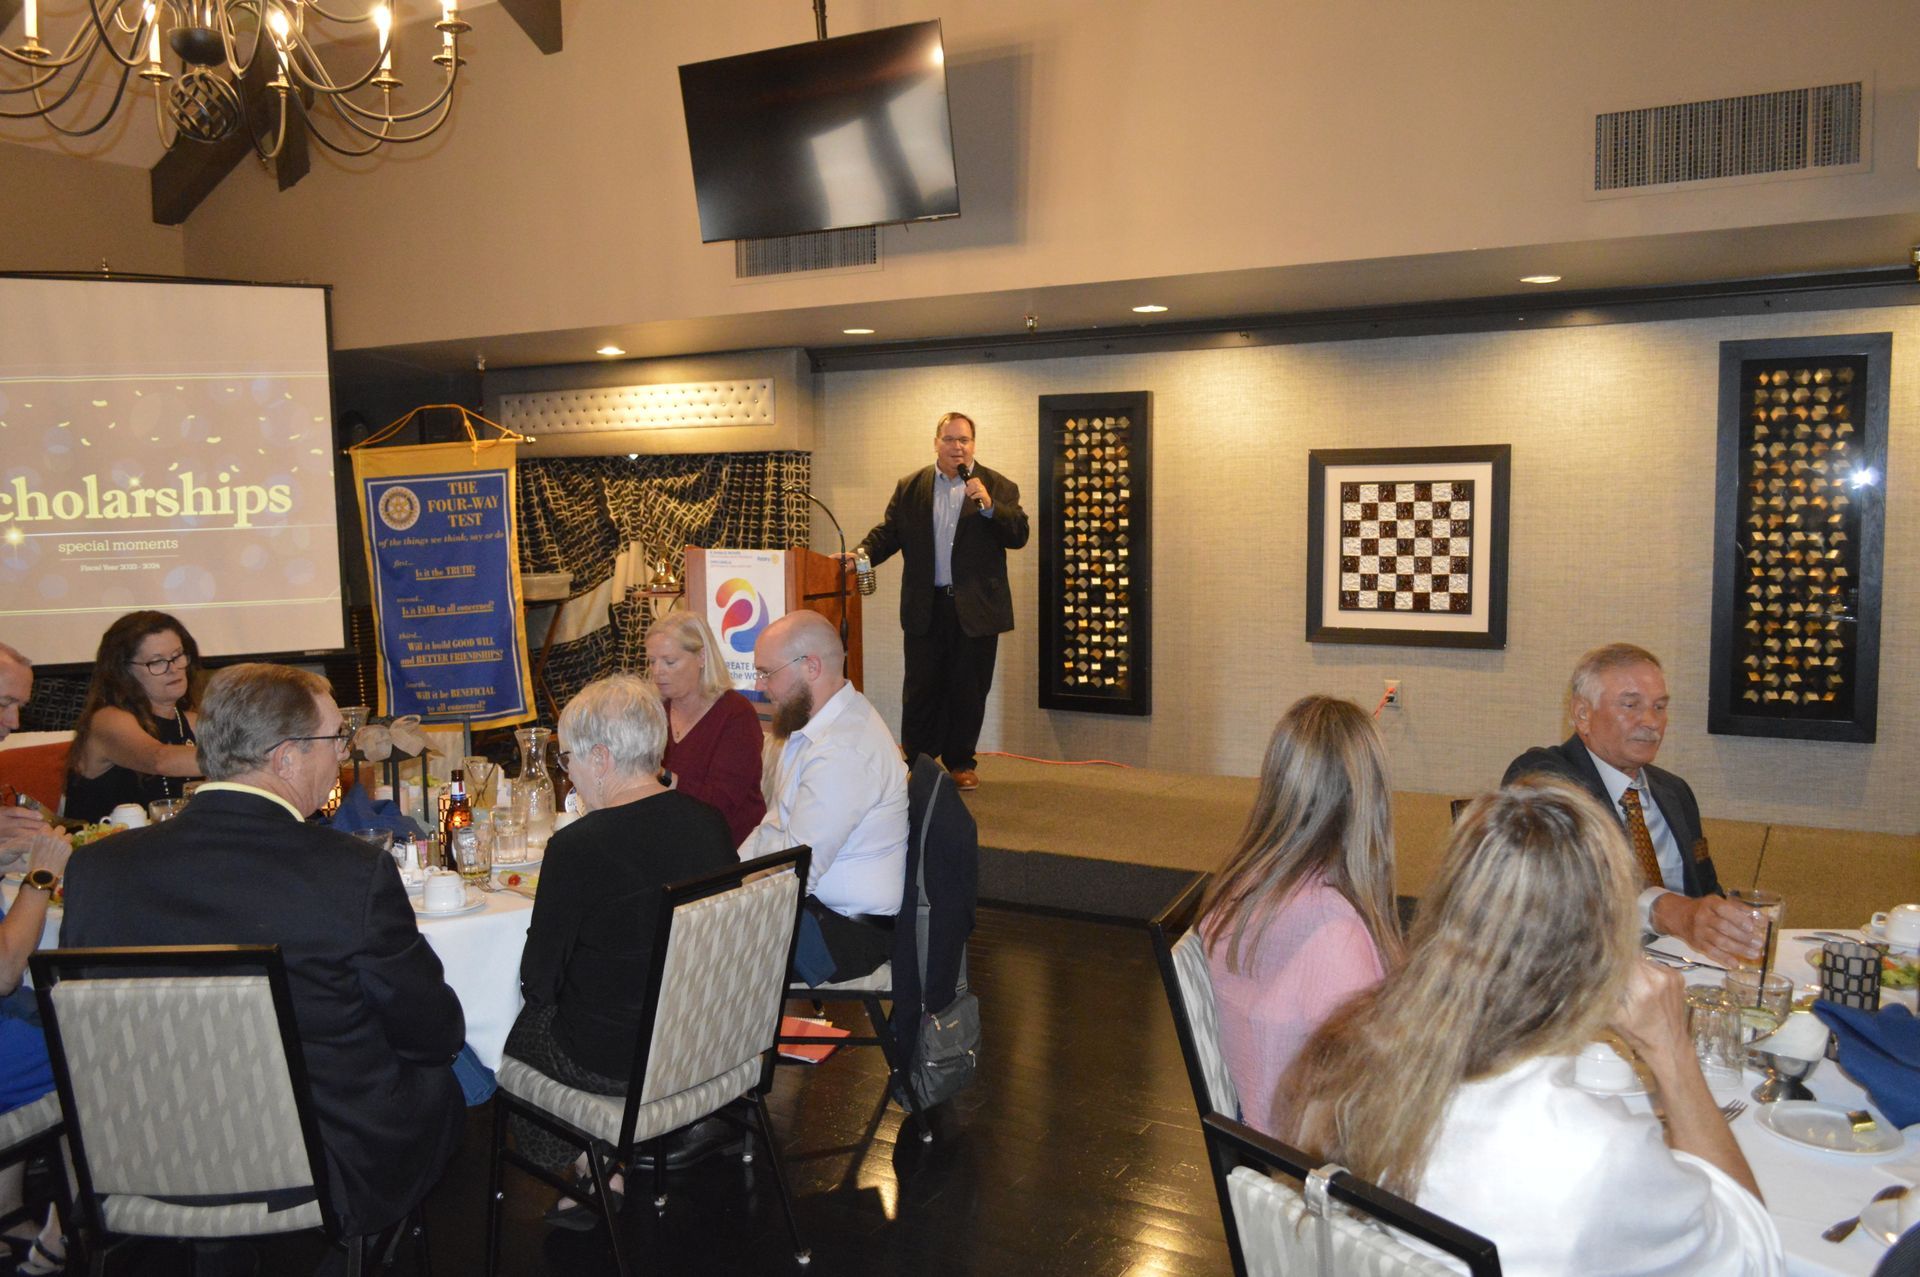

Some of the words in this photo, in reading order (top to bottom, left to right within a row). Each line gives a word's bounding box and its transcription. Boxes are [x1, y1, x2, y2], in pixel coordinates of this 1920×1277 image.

[448, 481, 477, 495] THE
[428, 496, 499, 512] FOUR-WAY
[448, 513, 482, 528] TEST
[58, 540, 109, 555] special
[112, 539, 178, 551] moments
[390, 537, 401, 546] the
[403, 536, 428, 546] things
[80, 563, 101, 572] Fiscal
[102, 563, 120, 571] Year
[431, 568, 443, 577] the
[417, 604, 436, 615] FAIR
[407, 642, 423, 651] Will
[452, 638, 475, 648] GOOD
[475, 636, 495, 646] WILL
[400, 656, 415, 665] and
[416, 653, 448, 663] BETTER
[450, 686, 496, 698] BENEFICIAL
